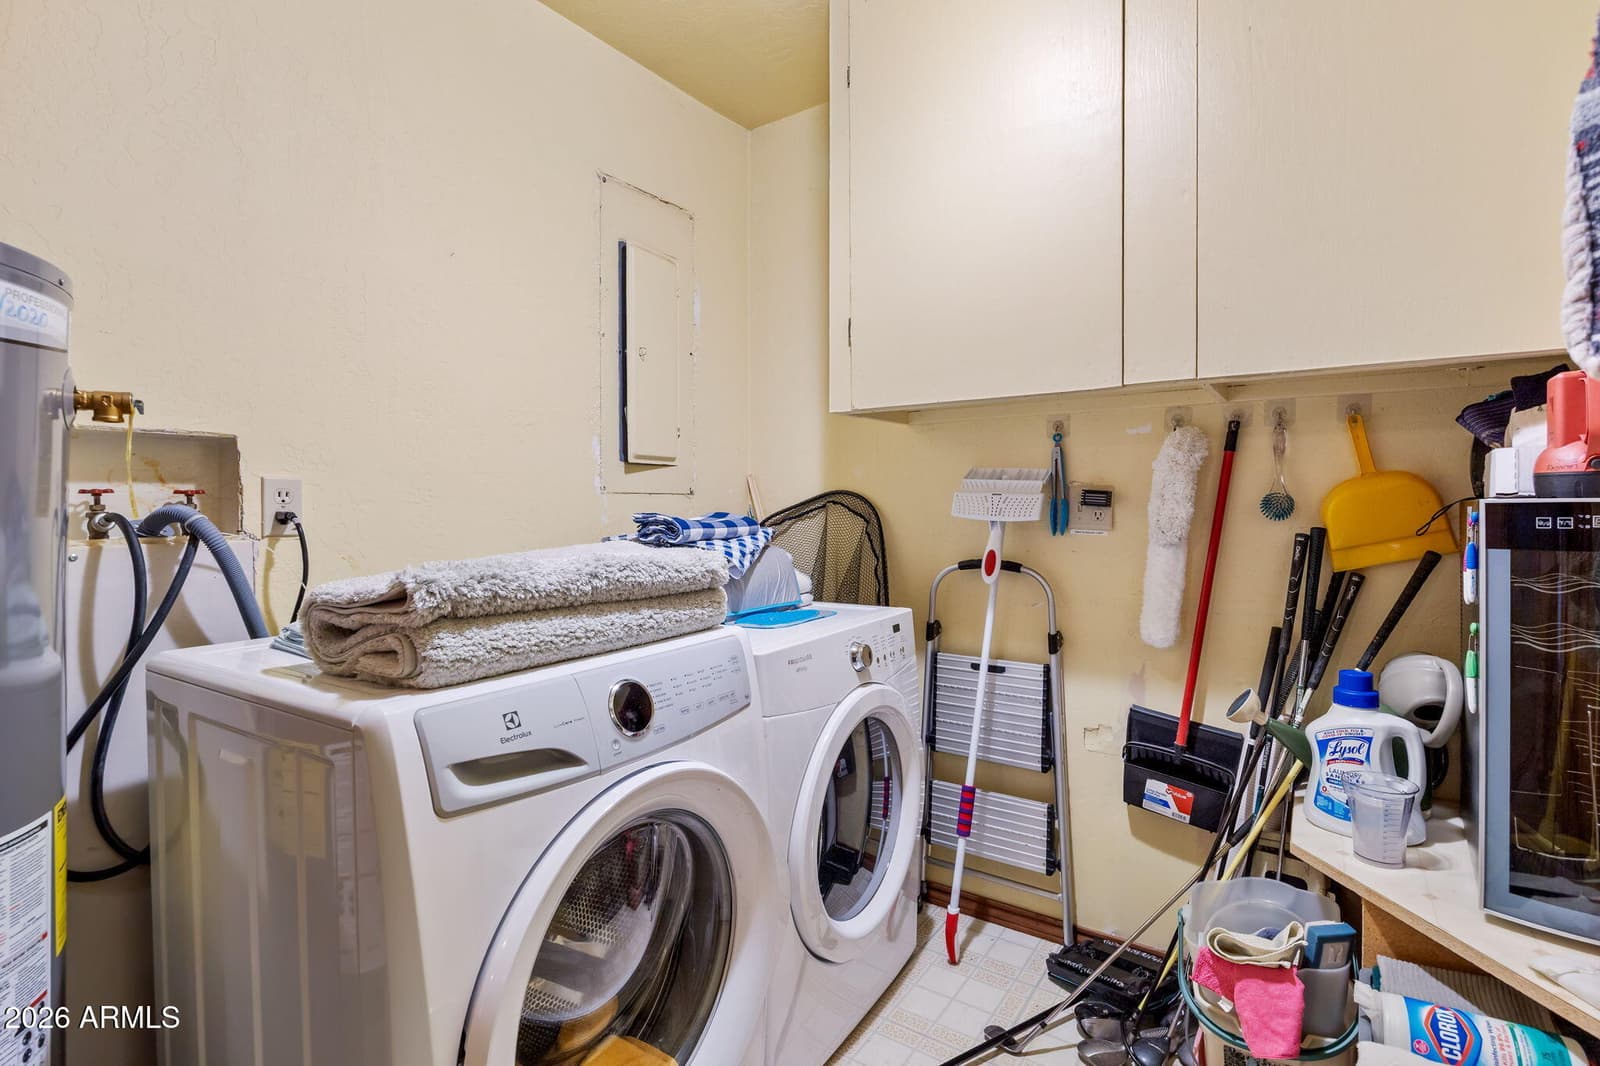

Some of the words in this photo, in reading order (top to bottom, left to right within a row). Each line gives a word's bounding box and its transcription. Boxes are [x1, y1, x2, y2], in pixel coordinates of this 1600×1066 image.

[500, 731, 532, 745] Electrolux
[1328, 740, 1365, 758] Lysol
[1435, 1007, 1462, 1062] CLOROX
